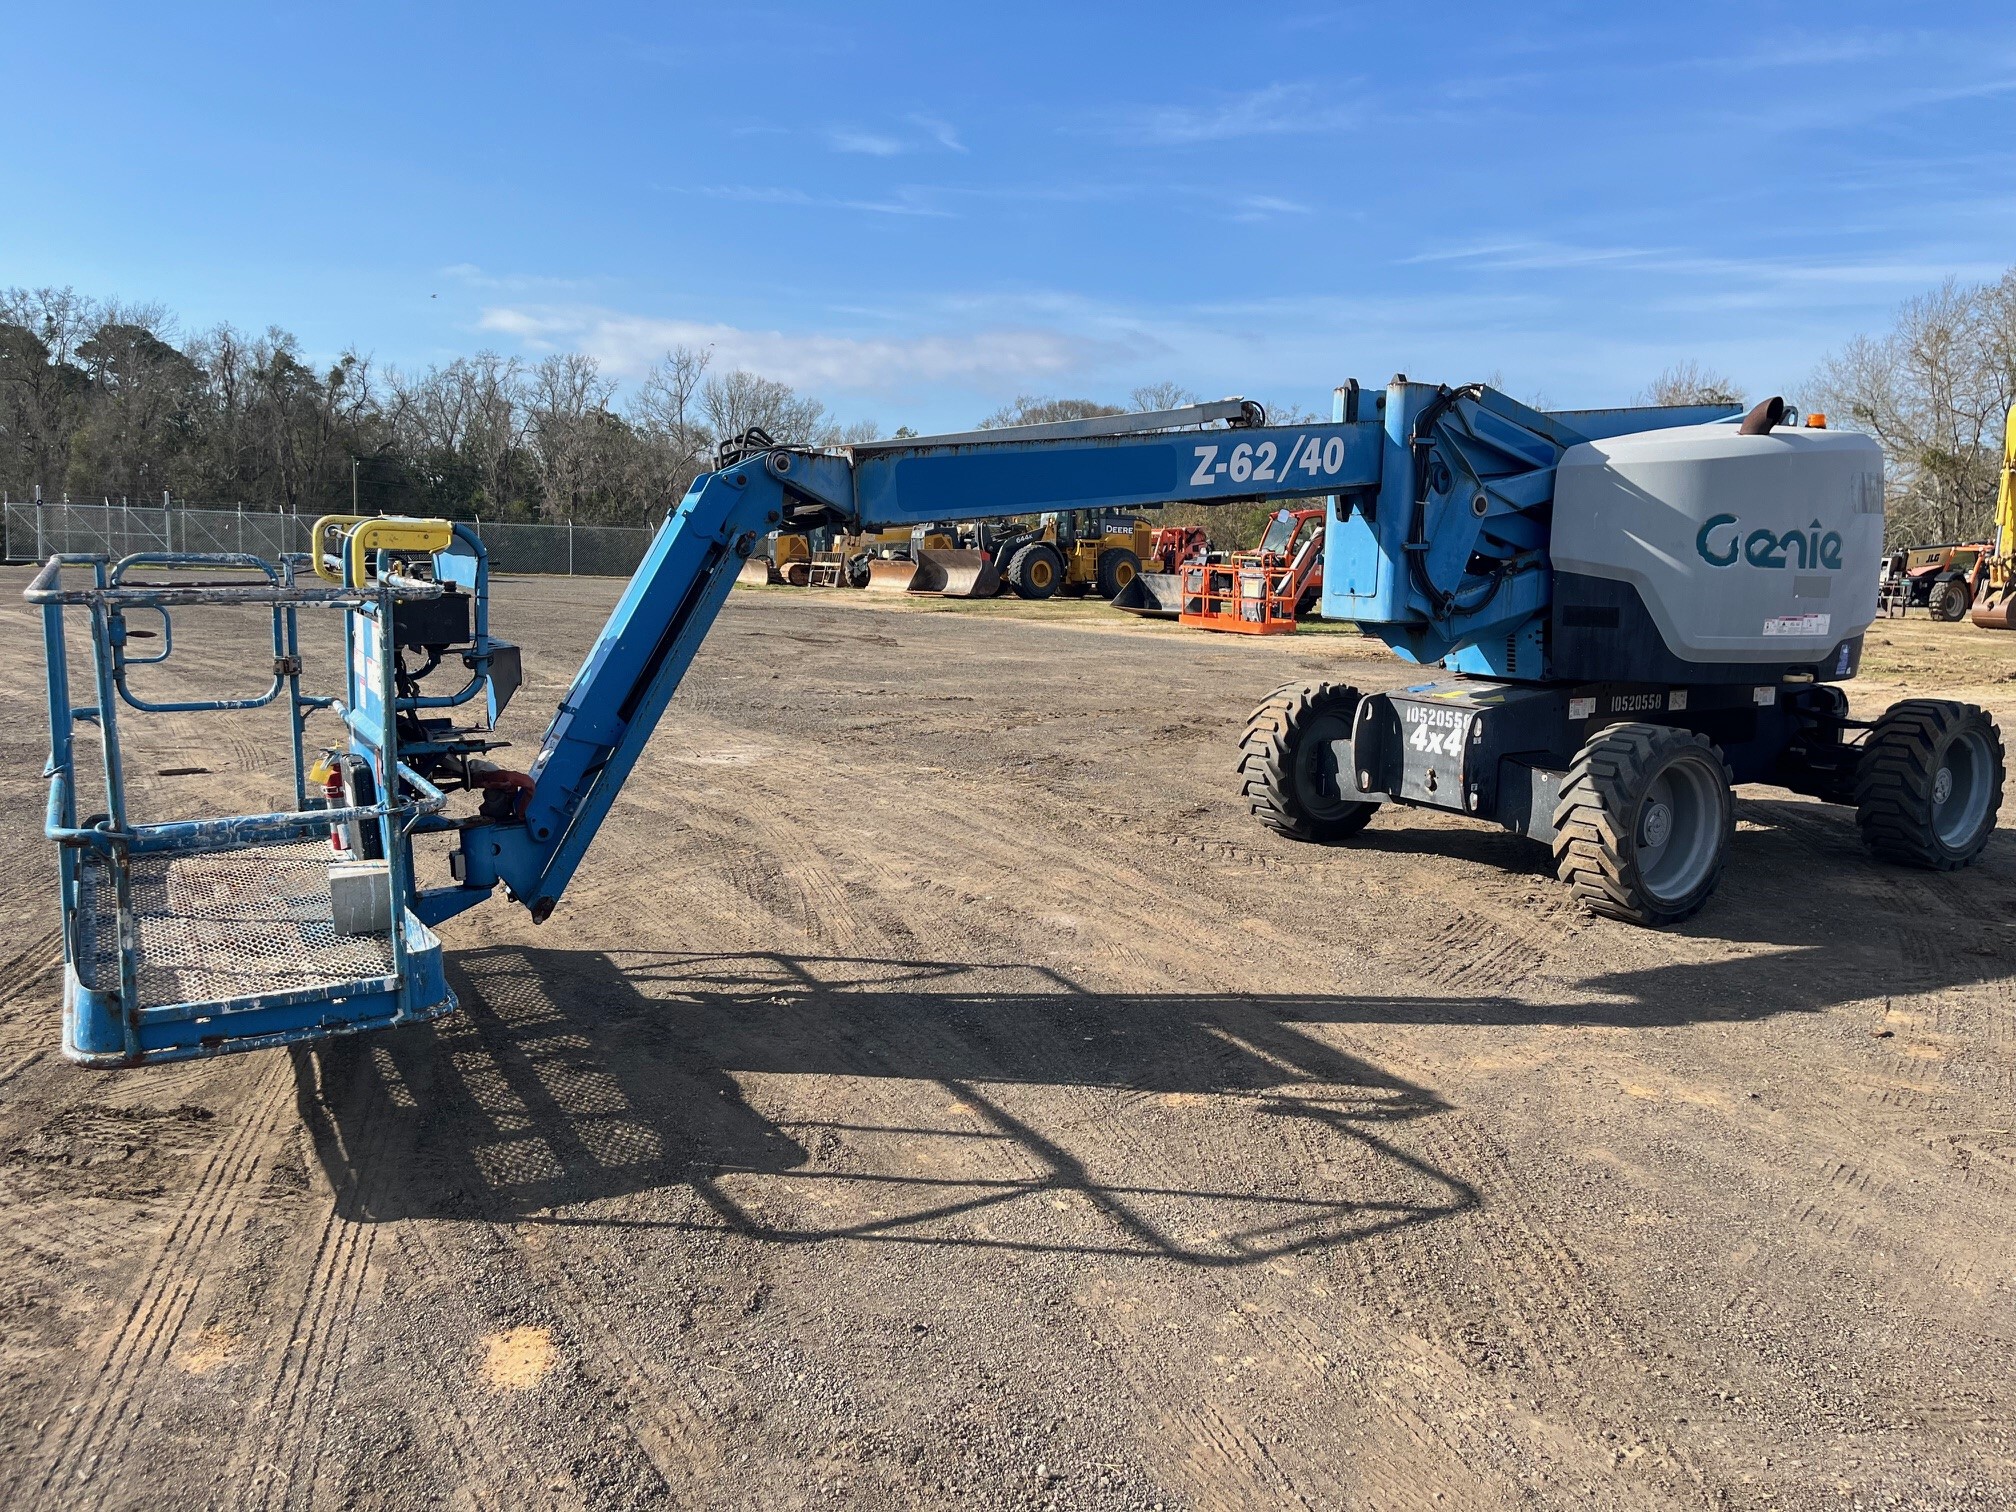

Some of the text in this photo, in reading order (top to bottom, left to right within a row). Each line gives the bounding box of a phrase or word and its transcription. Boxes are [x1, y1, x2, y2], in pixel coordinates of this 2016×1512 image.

[1189, 434, 1345, 486] Z-62/40
[1105, 524, 1134, 534] DEERE
[1696, 513, 1843, 569] Genie
[1925, 553, 1941, 563] JLG
[1610, 694, 1662, 712] 10520558
[1409, 723, 1463, 757] 4x4
